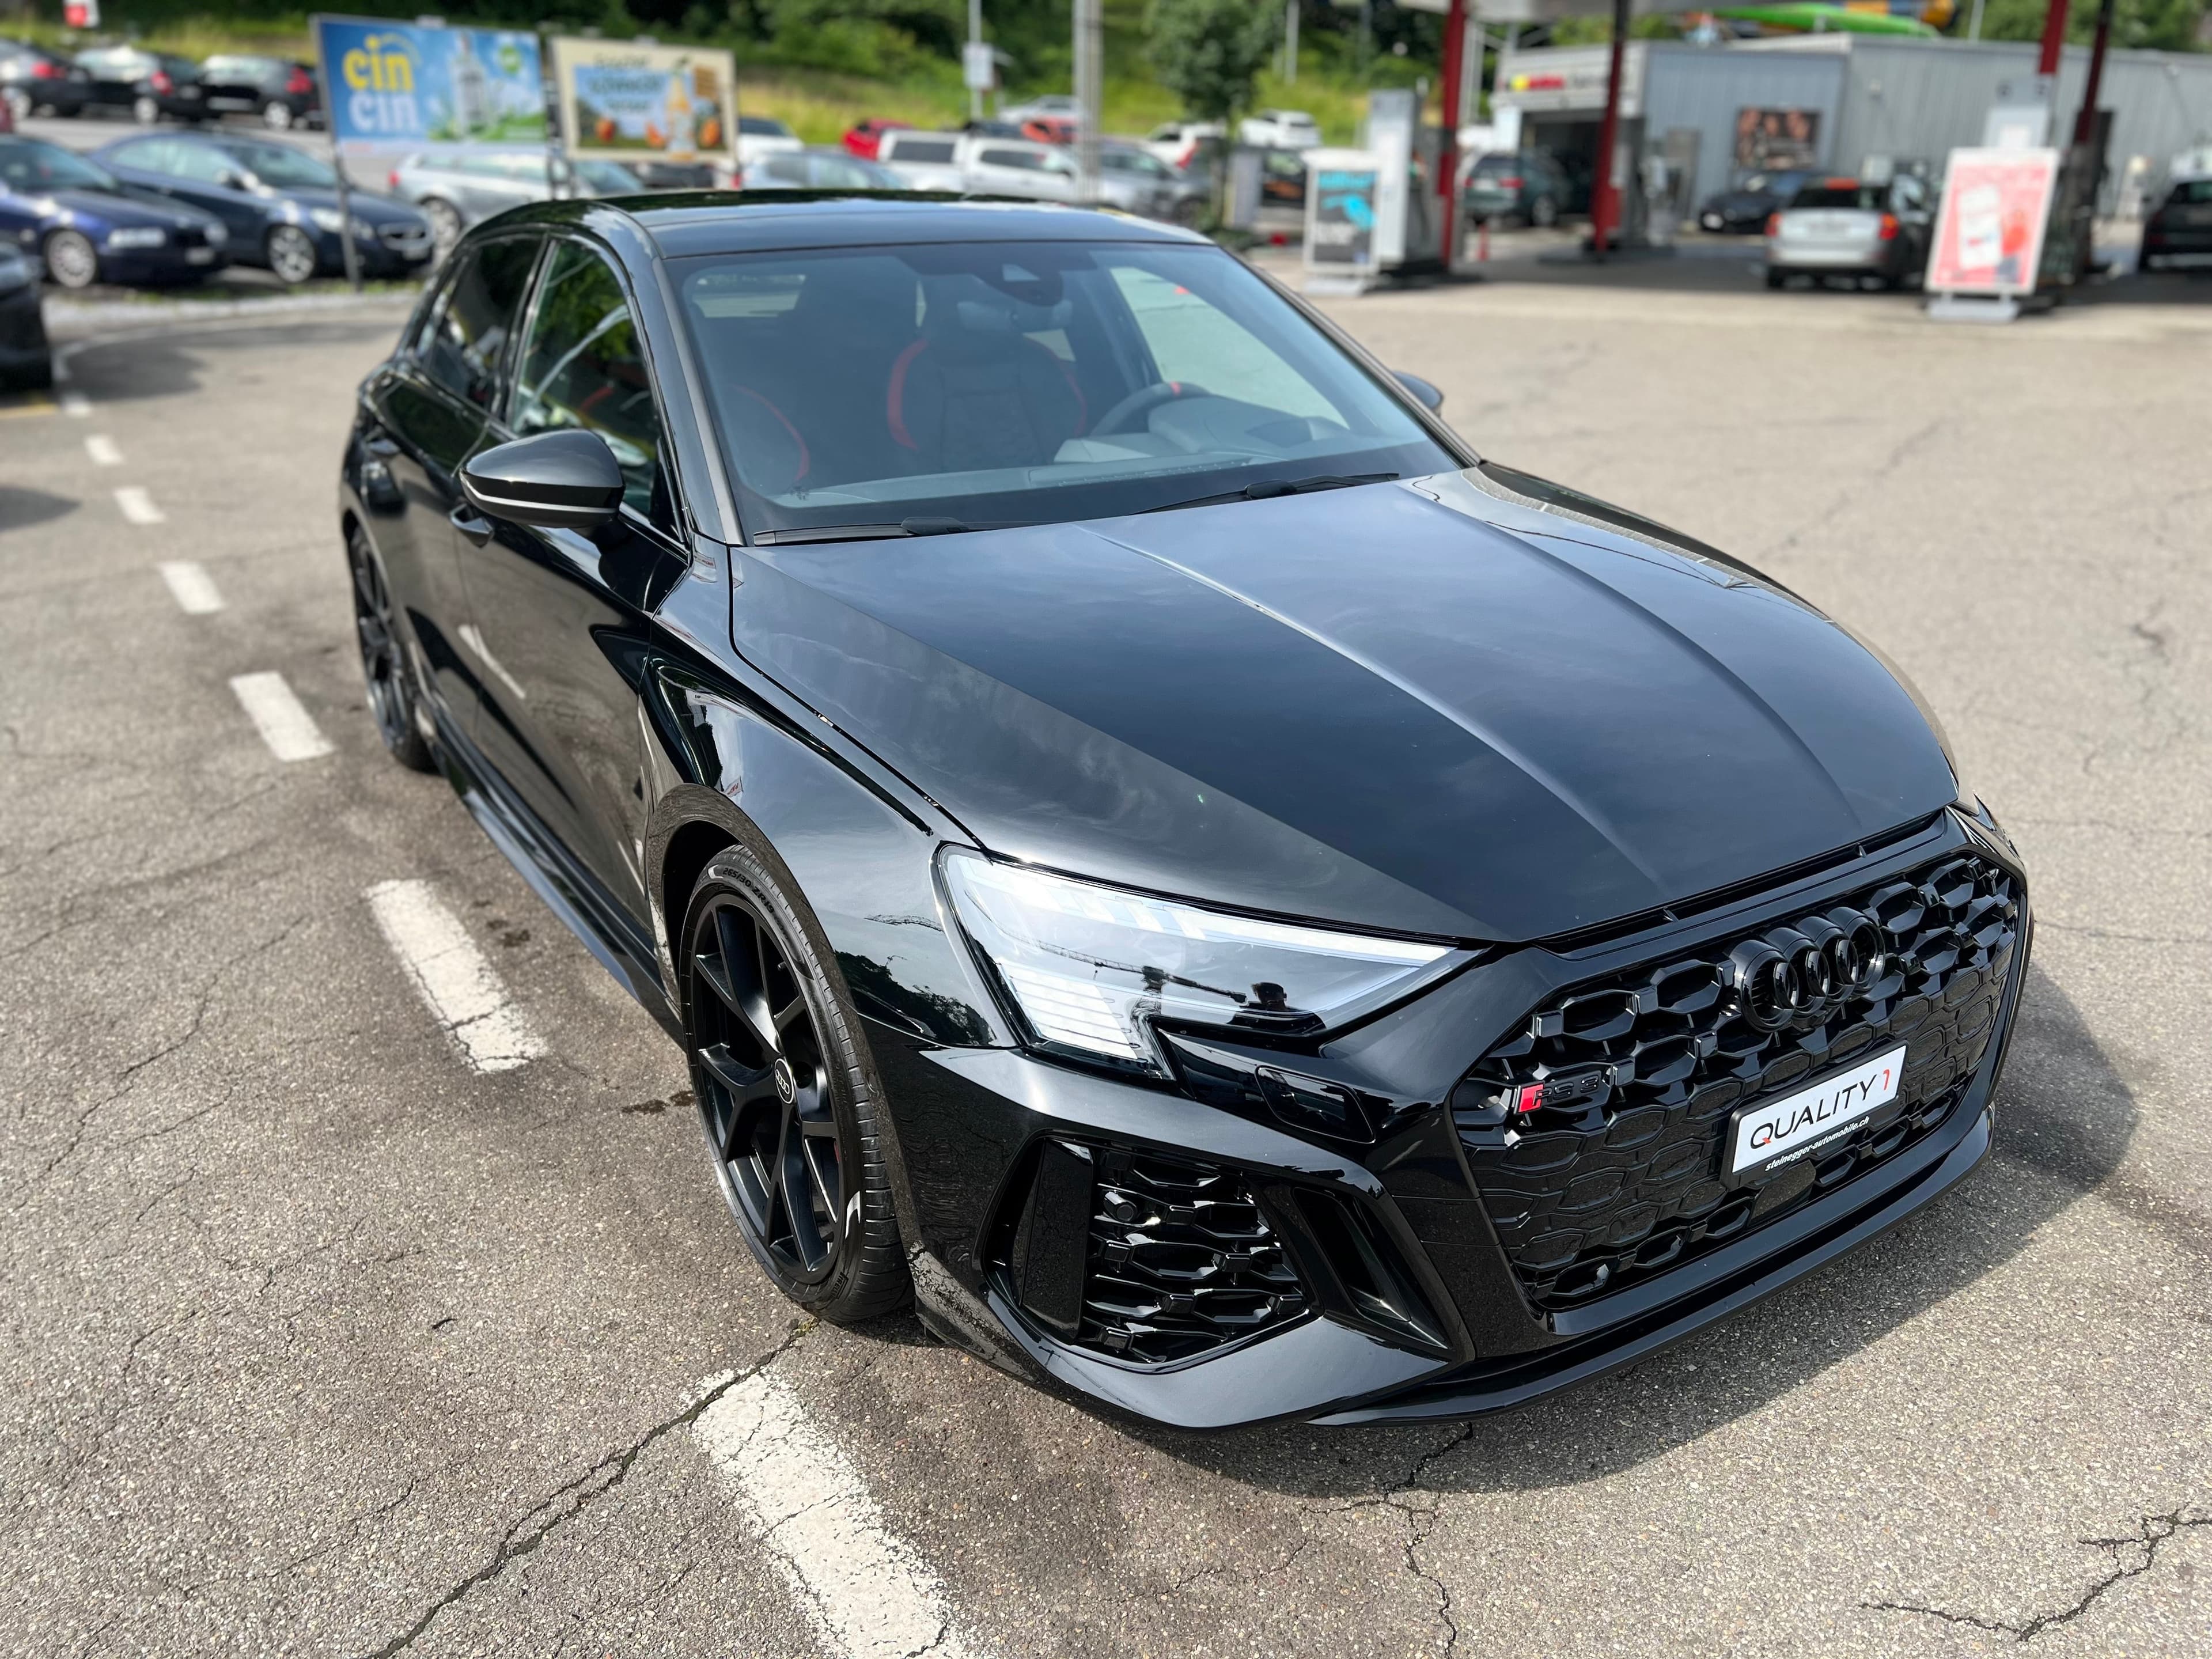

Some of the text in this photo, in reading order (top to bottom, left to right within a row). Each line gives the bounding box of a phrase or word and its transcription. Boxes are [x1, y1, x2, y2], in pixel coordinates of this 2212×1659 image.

[342, 35, 414, 92] cin
[349, 93, 419, 132] cin
[722, 867, 775, 914] 265/30 ZR19
[1532, 1082, 1575, 1107] RS
[1764, 1115, 1870, 1172] steinegger-automobile.ch
